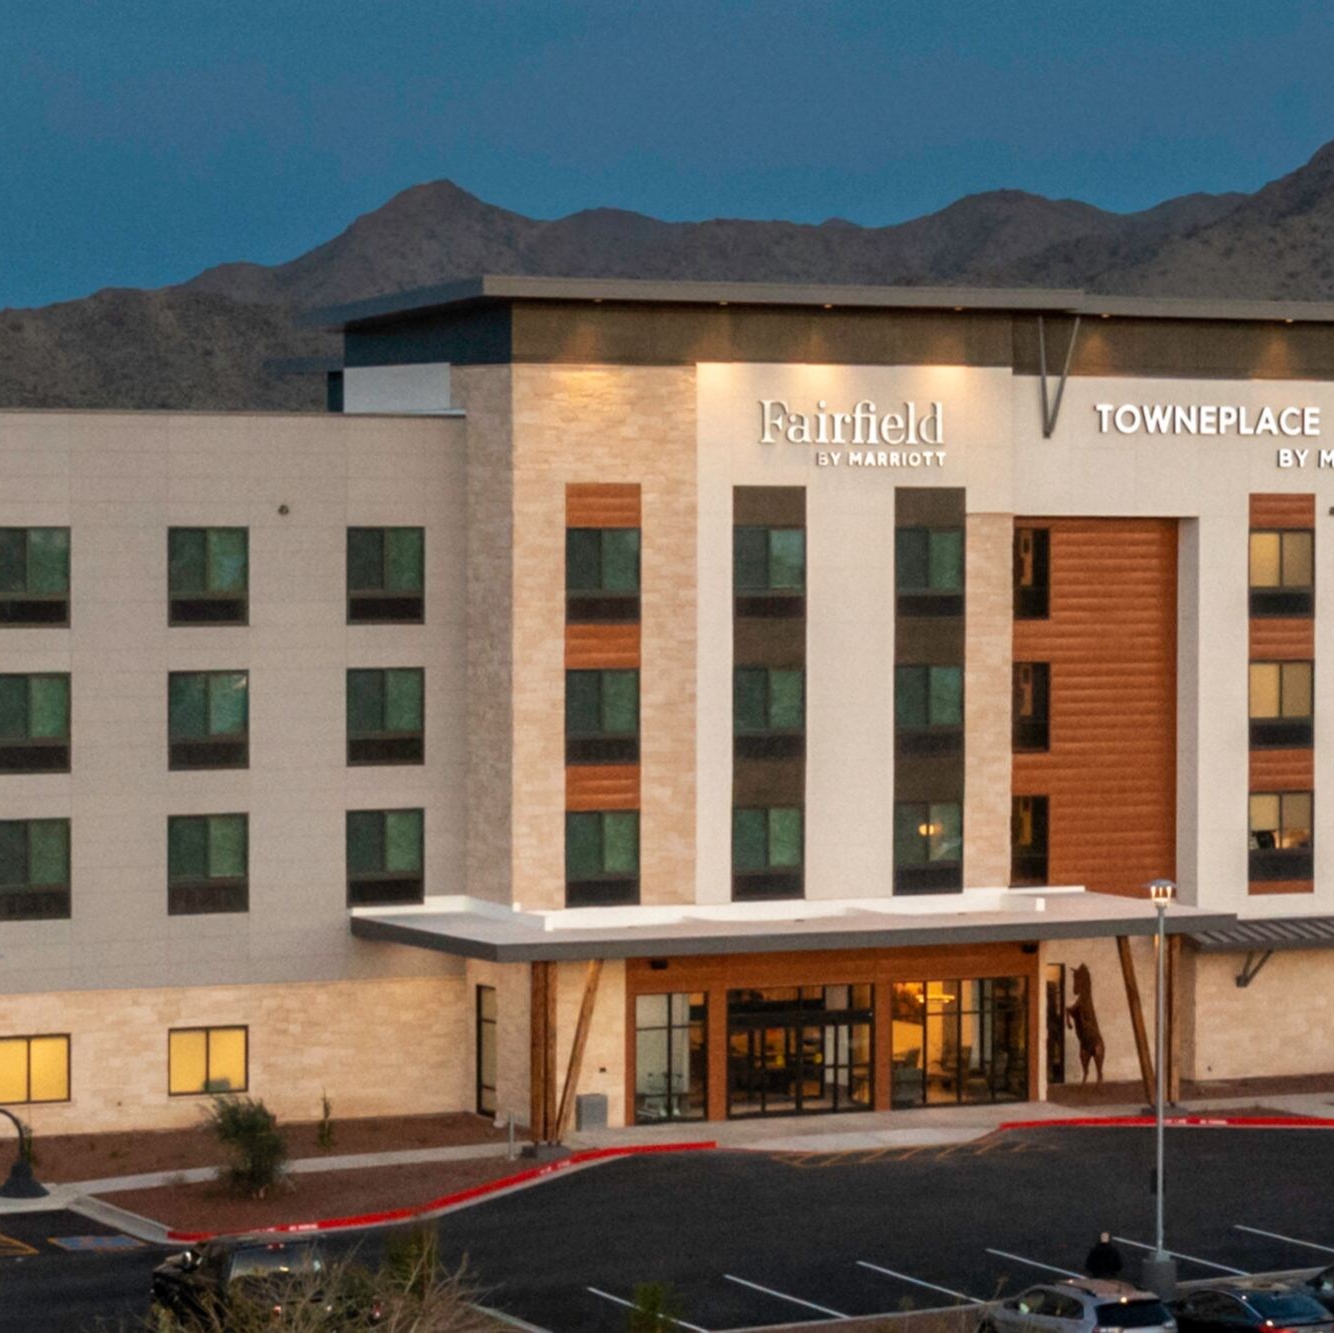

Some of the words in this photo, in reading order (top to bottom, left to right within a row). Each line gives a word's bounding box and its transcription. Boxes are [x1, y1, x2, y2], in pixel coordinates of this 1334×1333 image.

[759, 399, 945, 445] Fairfield
[1094, 403, 1321, 436] TOWNEPLACE
[817, 451, 842, 467] BY
[848, 451, 947, 467] MARRIOTT
[1277, 448, 1310, 469] BY
